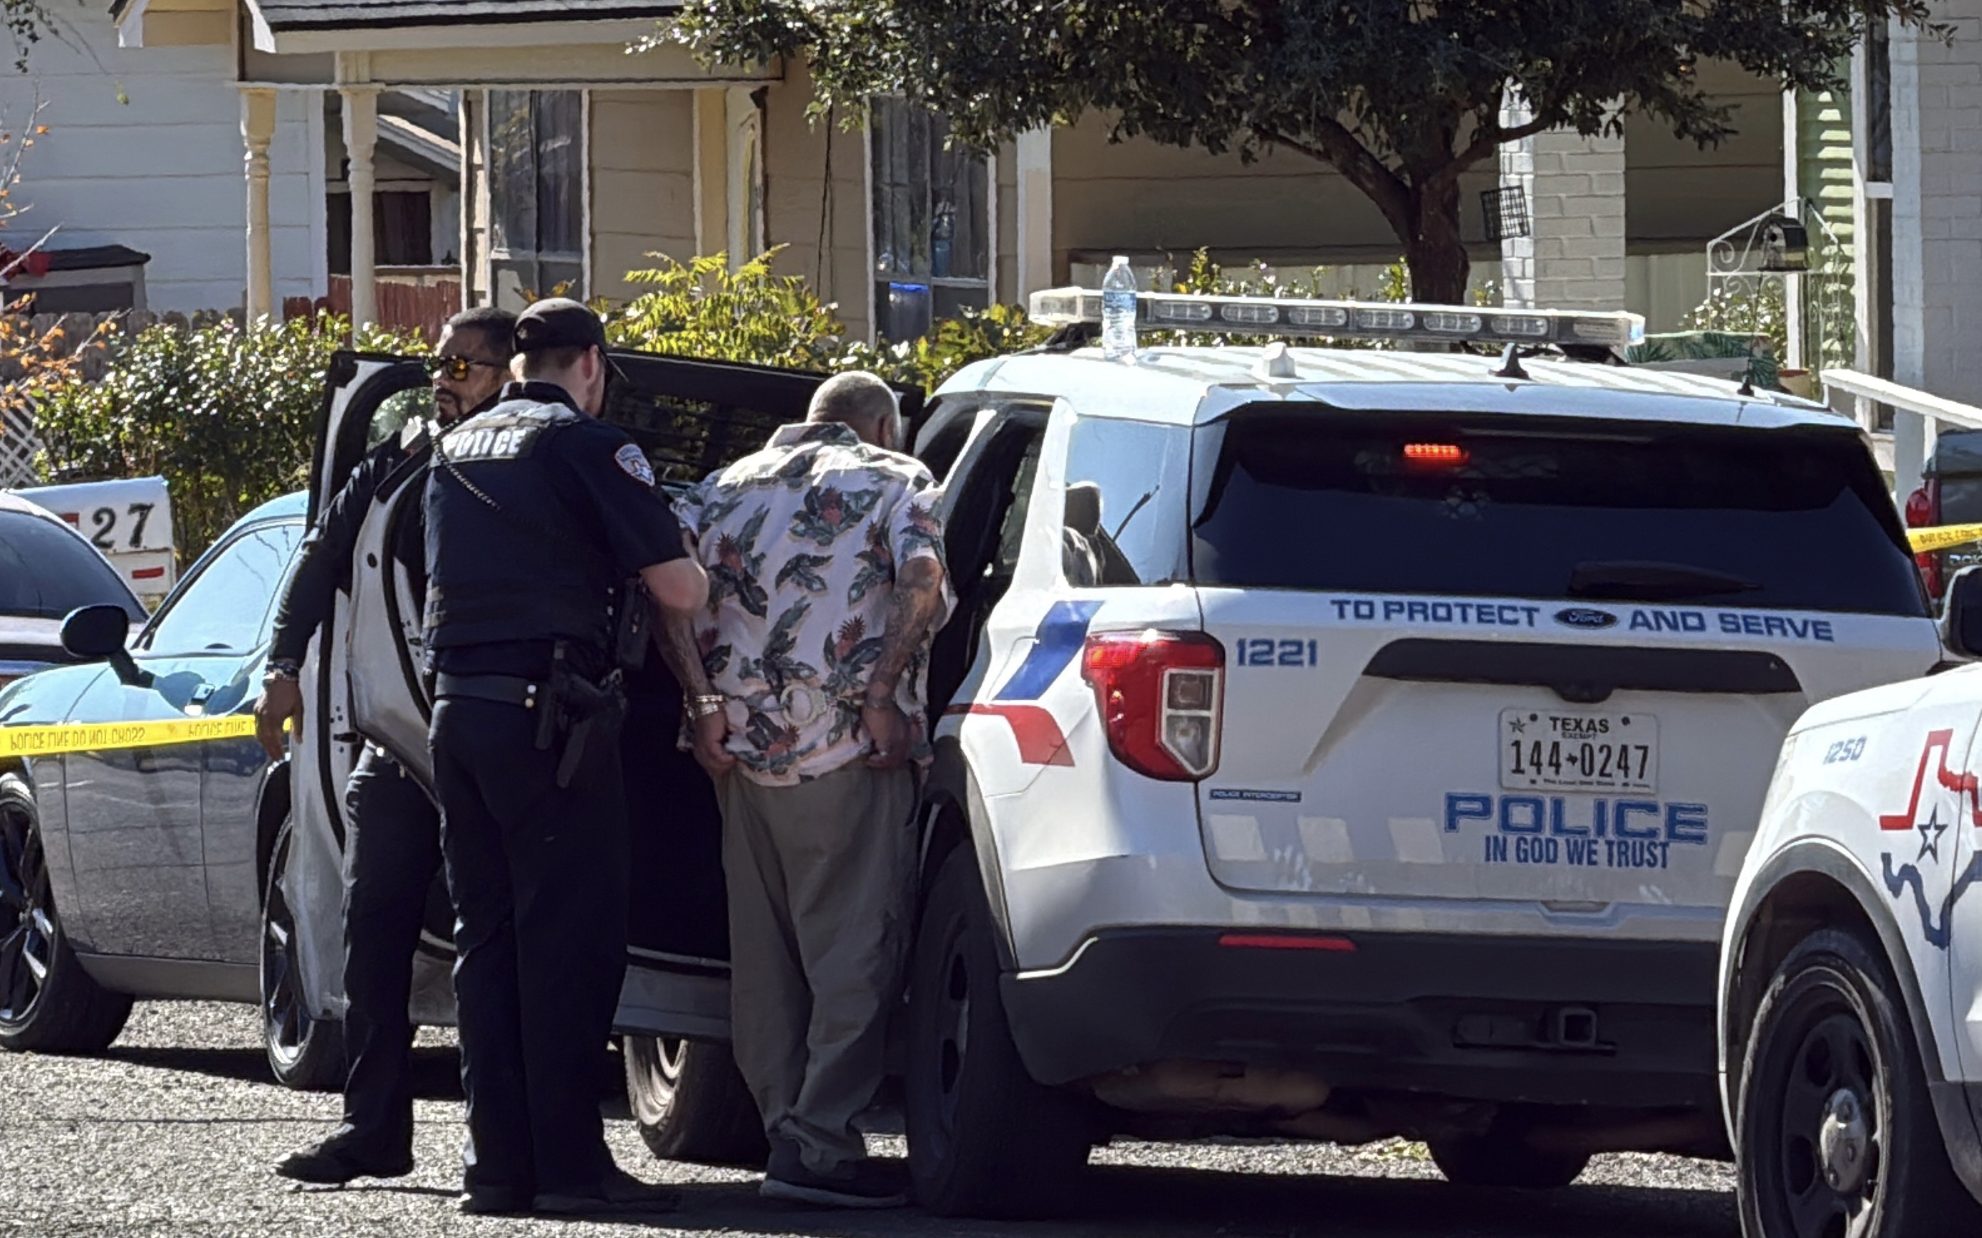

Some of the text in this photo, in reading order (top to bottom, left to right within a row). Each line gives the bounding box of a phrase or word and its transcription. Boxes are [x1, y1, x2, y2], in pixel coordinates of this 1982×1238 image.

[441, 428, 527, 457] POLICE
[91, 503, 154, 549] 27
[1331, 599, 1540, 627] TO PROTECT
[1629, 610, 1835, 643] AND SERVE
[1237, 638, 1317, 667] 1221
[1549, 716, 1609, 733] TEXAS
[1822, 736, 1867, 765] 1250
[1445, 792, 1708, 845] POLICE
[1485, 836, 1670, 869] IN GOD WE TRUST
